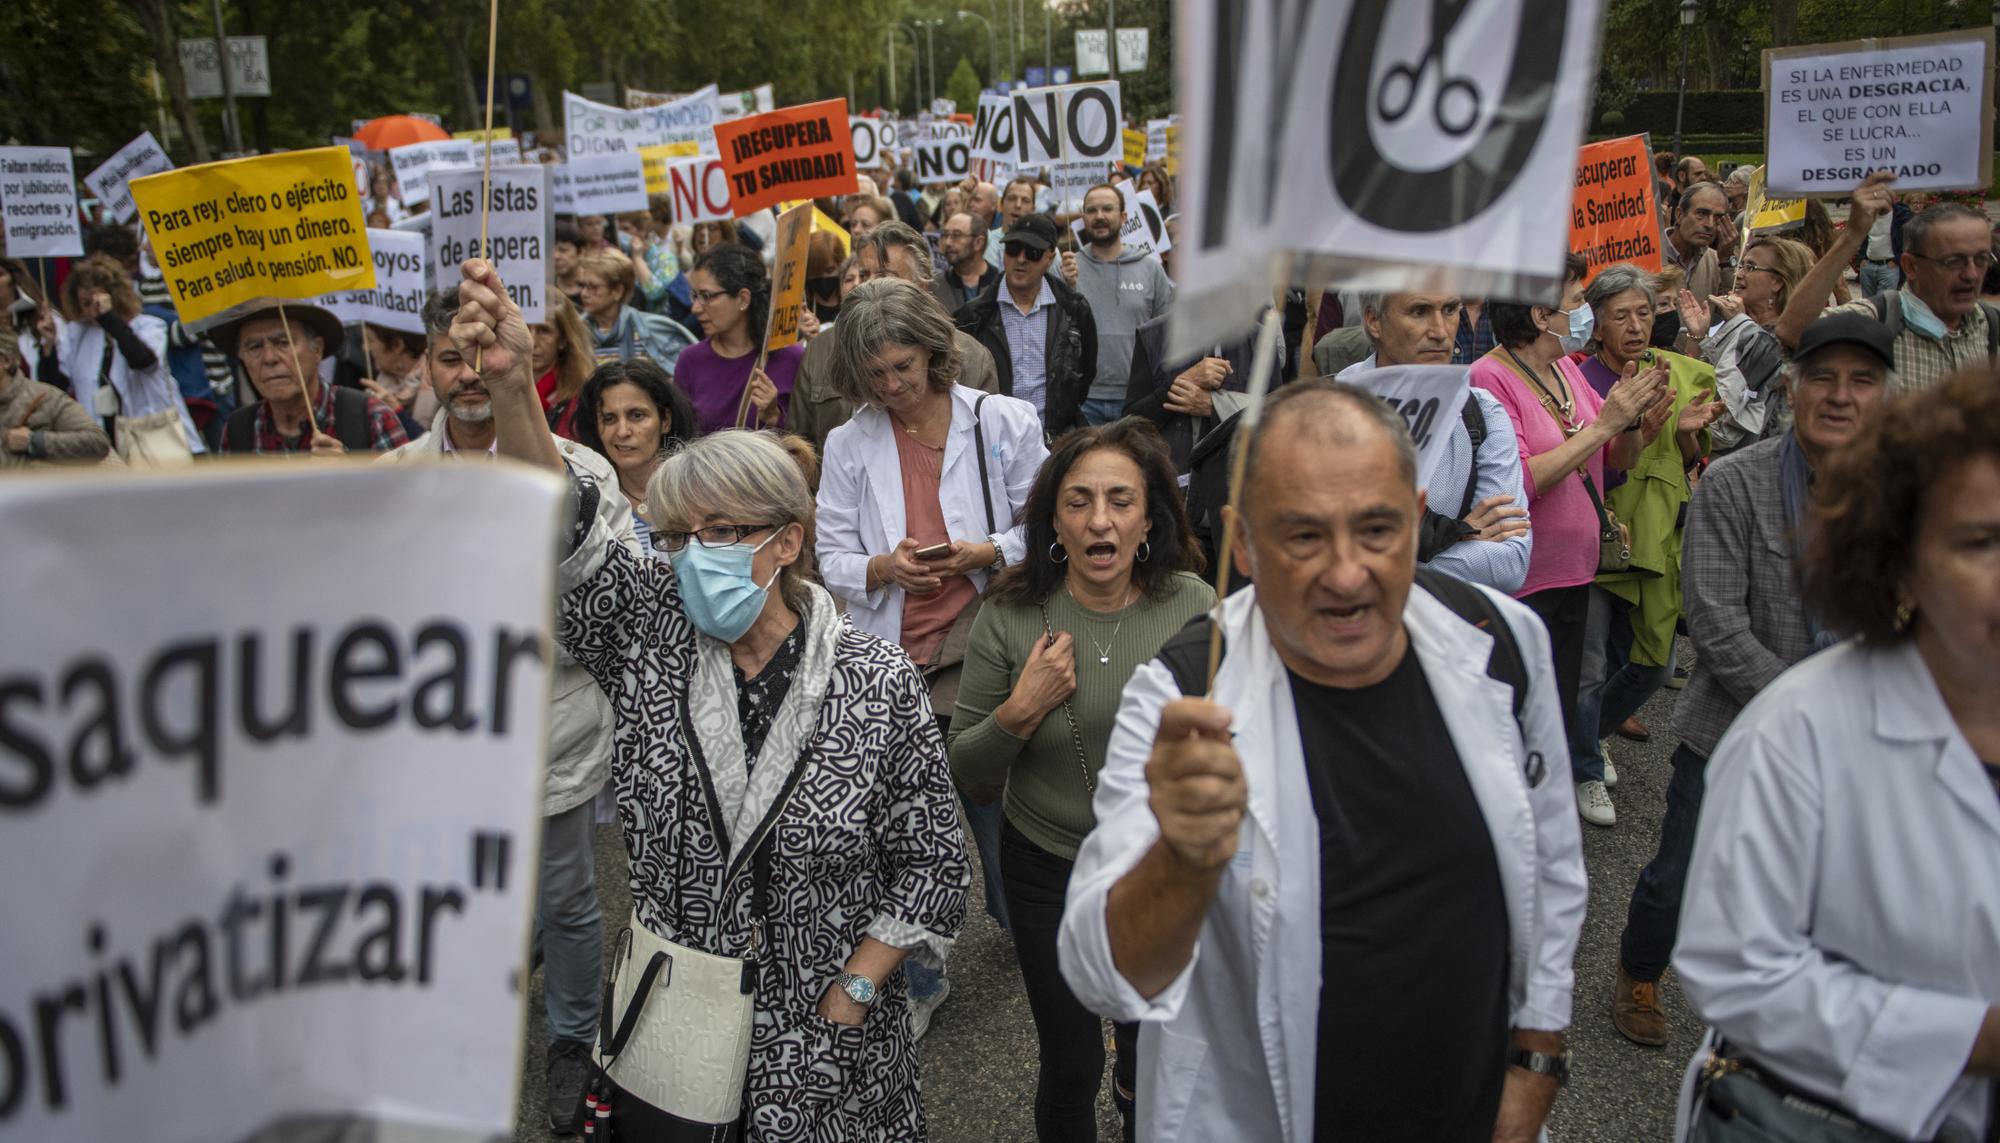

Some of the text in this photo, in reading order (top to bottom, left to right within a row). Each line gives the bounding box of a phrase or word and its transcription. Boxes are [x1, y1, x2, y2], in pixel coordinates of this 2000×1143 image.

[1790, 57, 1963, 84] SI LA ENFERMEDAD
[1781, 77, 1971, 103] ES UNA DESGRACIA,
[1014, 87, 1117, 163] NO
[1798, 100, 1951, 123] EL QUE CON ELLA
[571, 134, 628, 154] DIGNA
[731, 117, 832, 164] ¡RECUPERA
[972, 105, 1014, 154] NO
[1823, 124, 1920, 141] SE LUCRA...
[1, 158, 70, 174] Faltan médicos,
[918, 143, 969, 177] NO
[1844, 146, 1896, 161] ES UN
[732, 152, 845, 198] TU SANIDAD!
[1055, 174, 1086, 187] Reortan
[1574, 155, 1637, 188] ecuperar
[4, 180, 72, 198] por jubilación,
[437, 184, 474, 219] Las
[670, 160, 732, 223] NO
[7, 201, 73, 218] recortes y
[148, 178, 348, 234] Para rey, clero o ejército
[1572, 188, 1646, 229] la Sanidad
[10, 222, 77, 240] emigración.
[165, 217, 356, 268] siempre hay un dinero.
[371, 250, 420, 277] oyos
[440, 235, 464, 267] de
[1579, 231, 1655, 268] rivatizada.
[175, 245, 363, 301] Para salud o pensión, NO.
[0, 613, 545, 818] saquear
